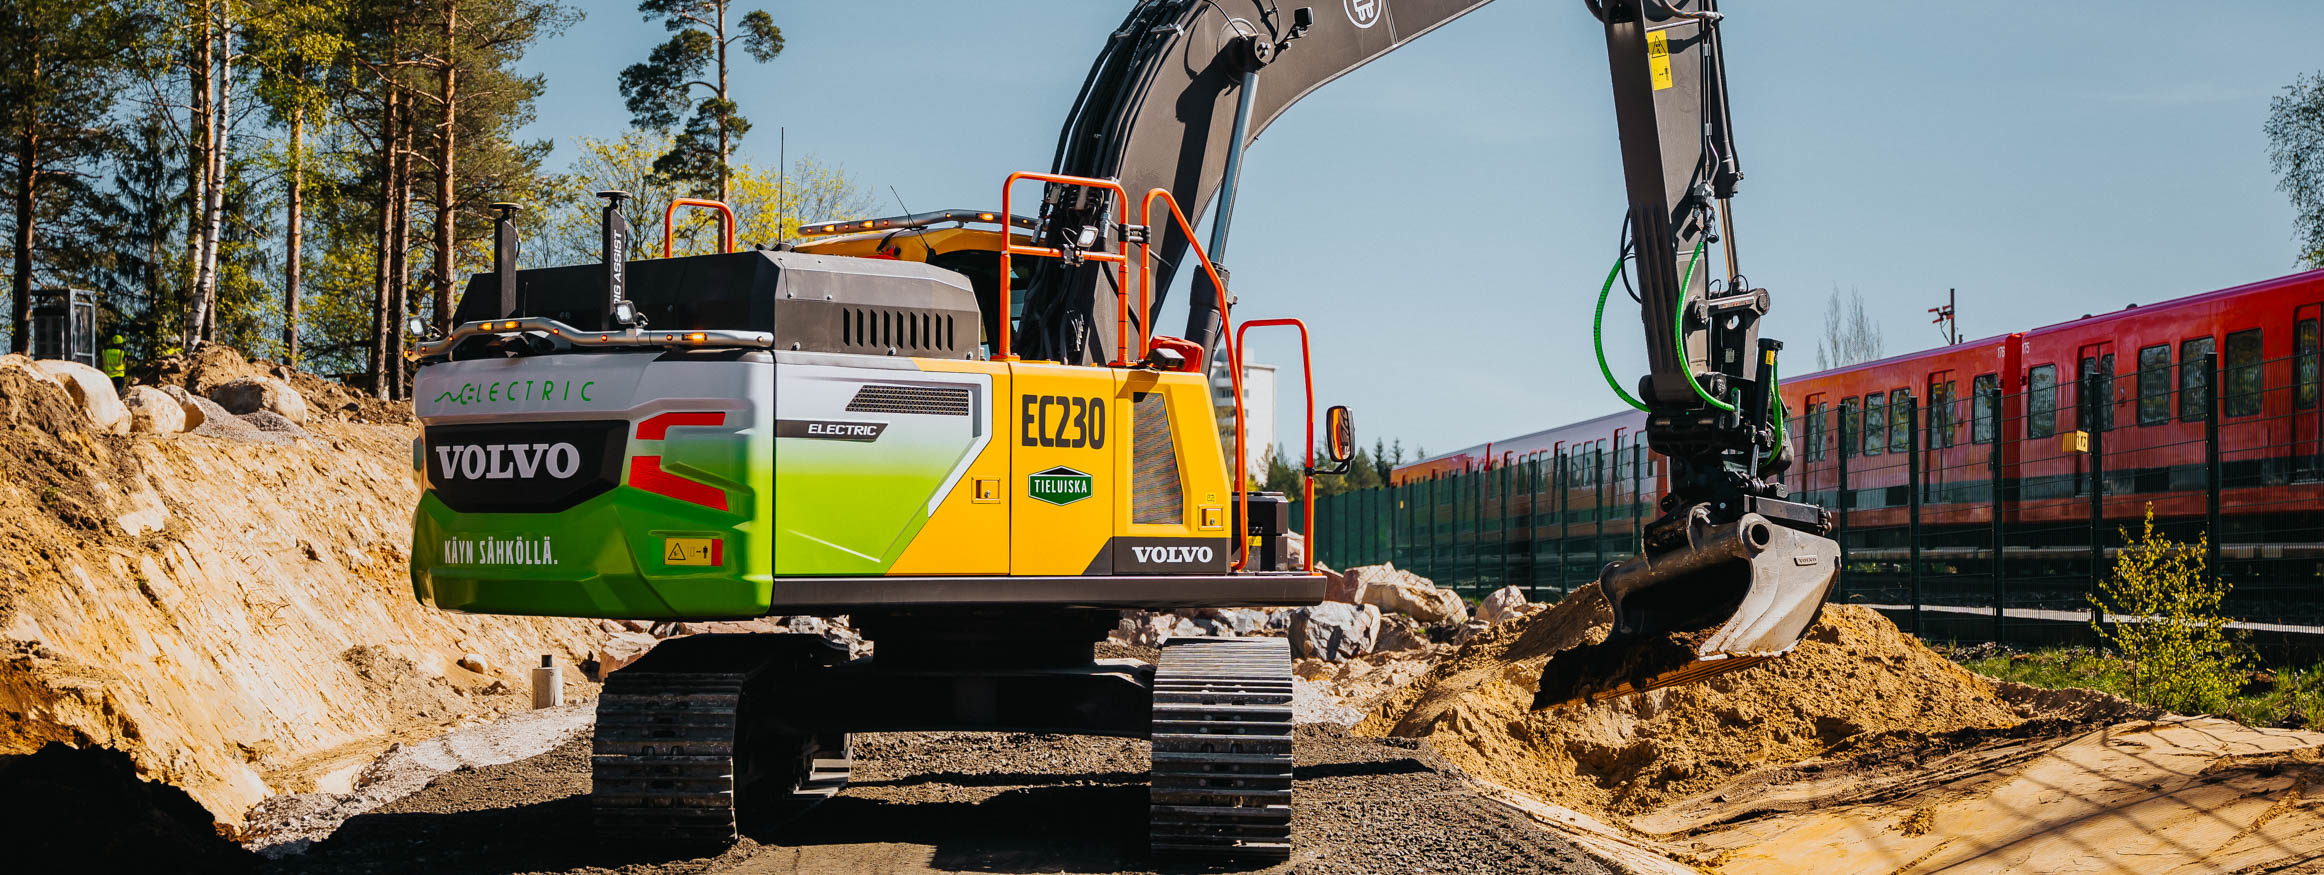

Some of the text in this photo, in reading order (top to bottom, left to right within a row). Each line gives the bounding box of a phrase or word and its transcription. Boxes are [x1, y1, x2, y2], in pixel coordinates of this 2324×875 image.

[613, 229, 622, 283] ASSIST
[808, 423, 877, 436] ELECTRIC
[1021, 394, 1106, 449] EC230
[435, 442, 580, 480] VOLVO
[1034, 479, 1087, 494] TIELUISKA
[444, 536, 558, 565] KÄYN SÄHKÖLLÄ.
[1131, 546, 1214, 564] VOLVO
